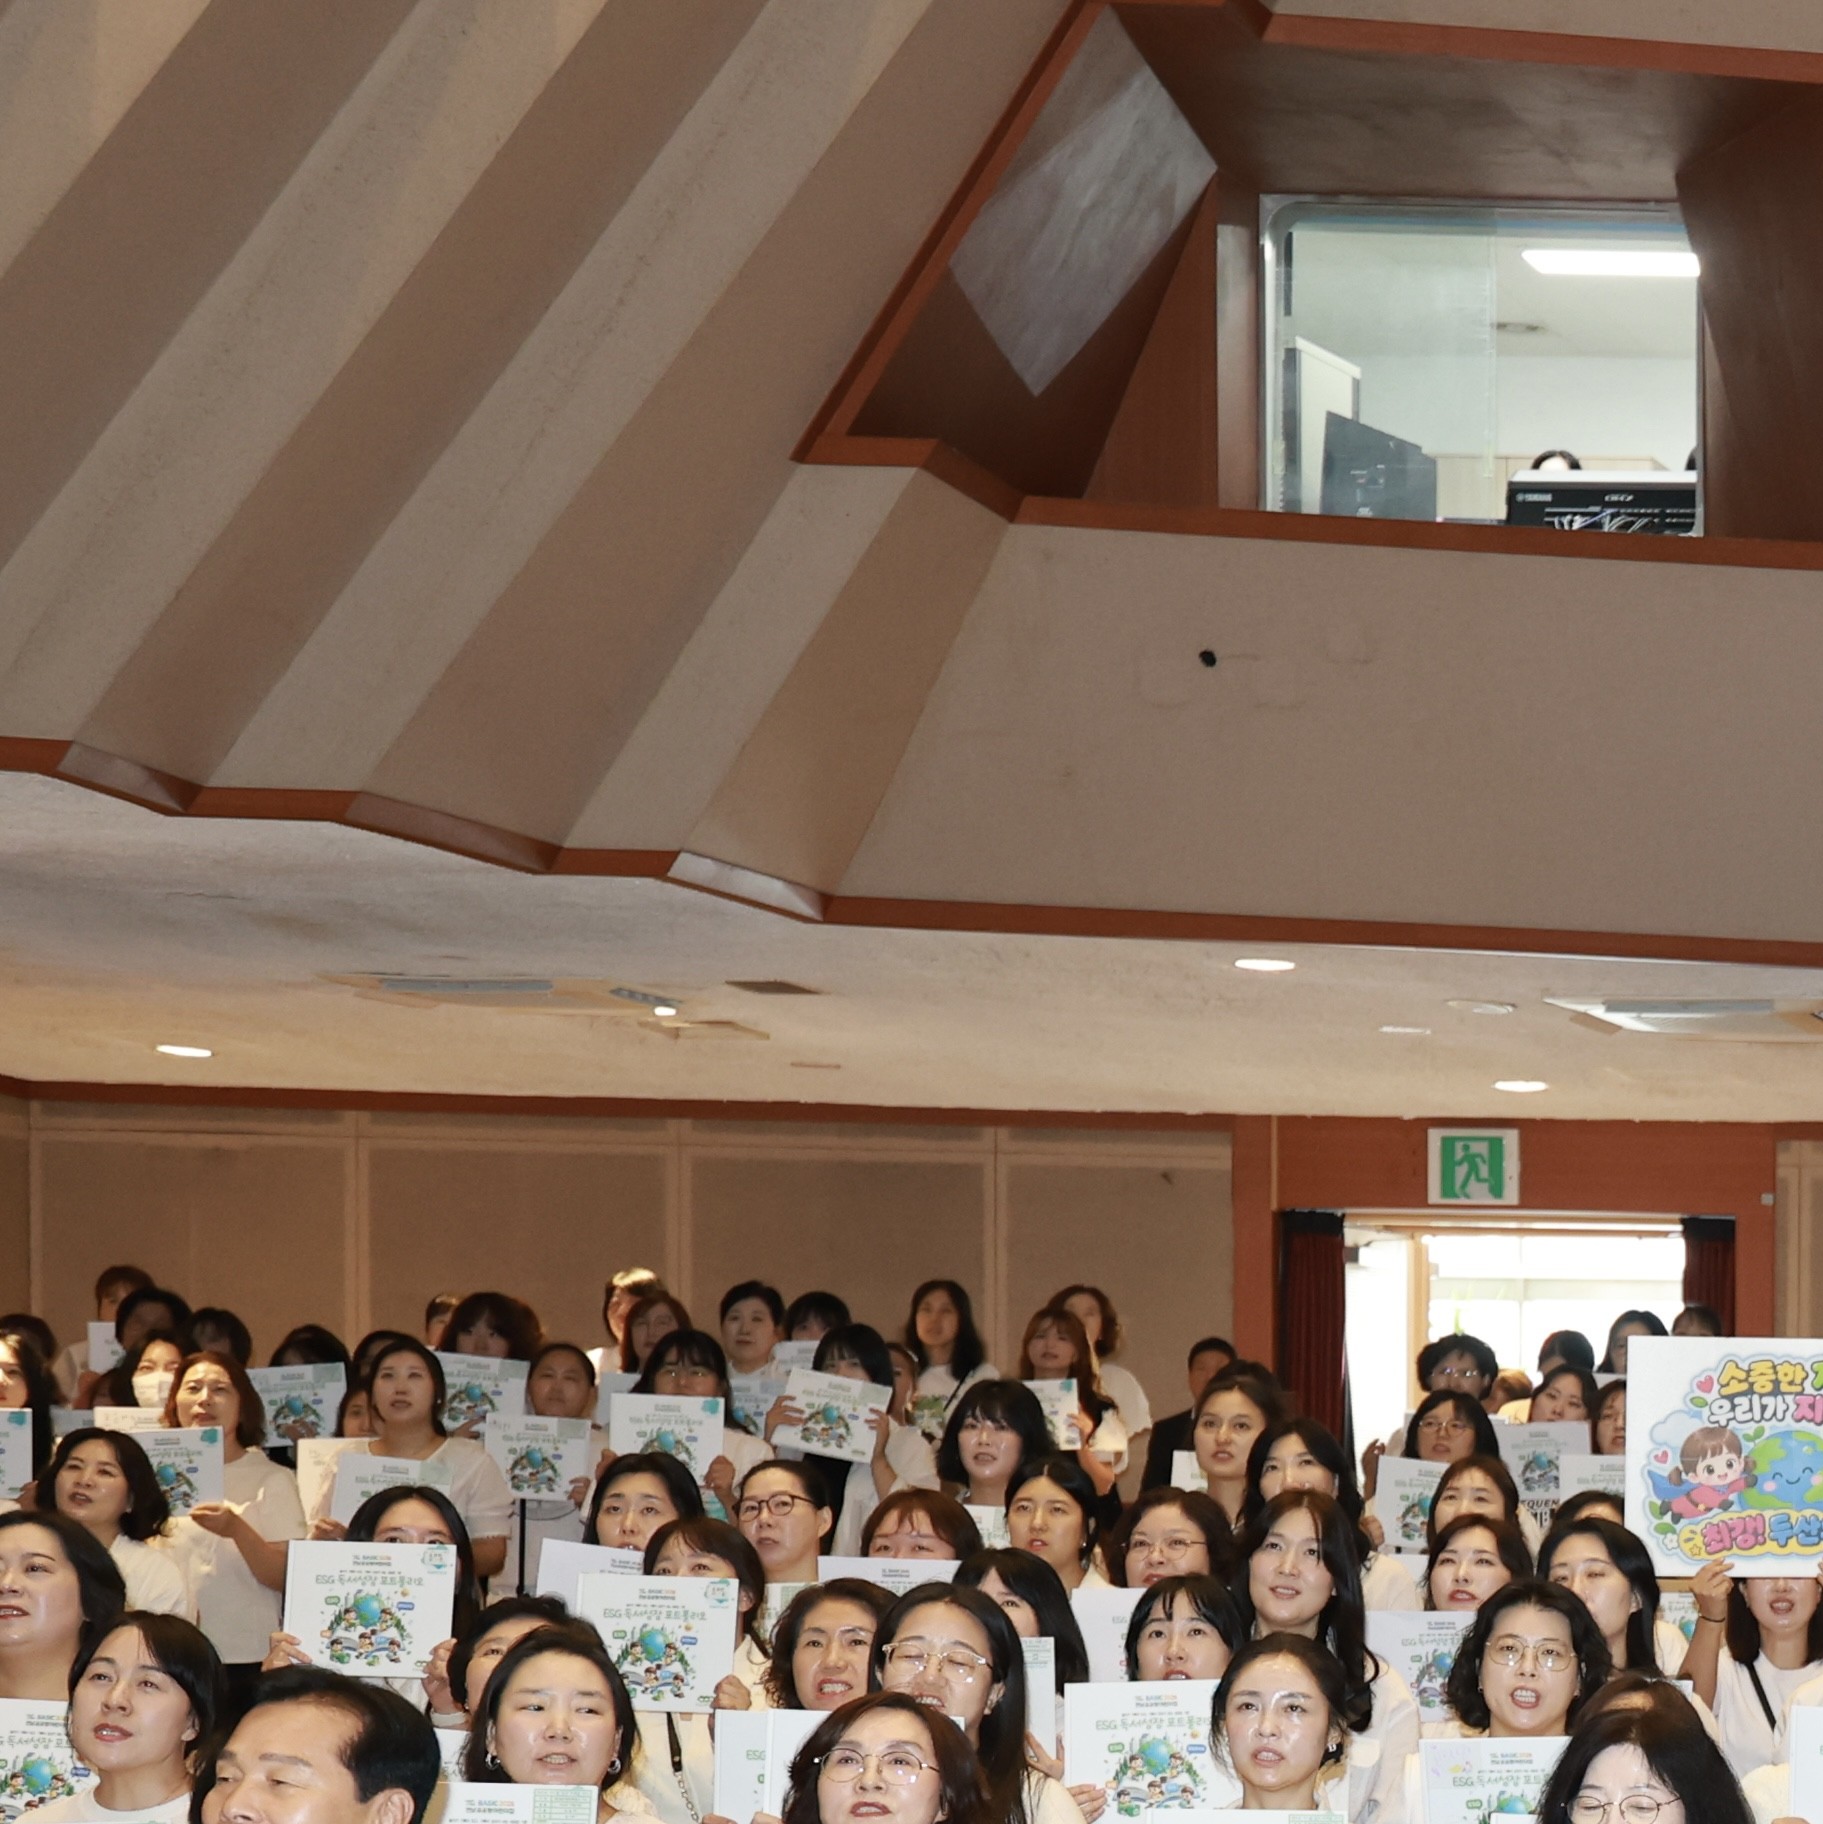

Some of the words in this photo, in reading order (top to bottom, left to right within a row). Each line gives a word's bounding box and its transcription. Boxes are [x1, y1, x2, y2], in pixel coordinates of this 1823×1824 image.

[1718, 1360, 1807, 1394] 소중한
[1708, 1397, 1788, 1425] 우리가
[1701, 1513, 1766, 1555] 최강!
